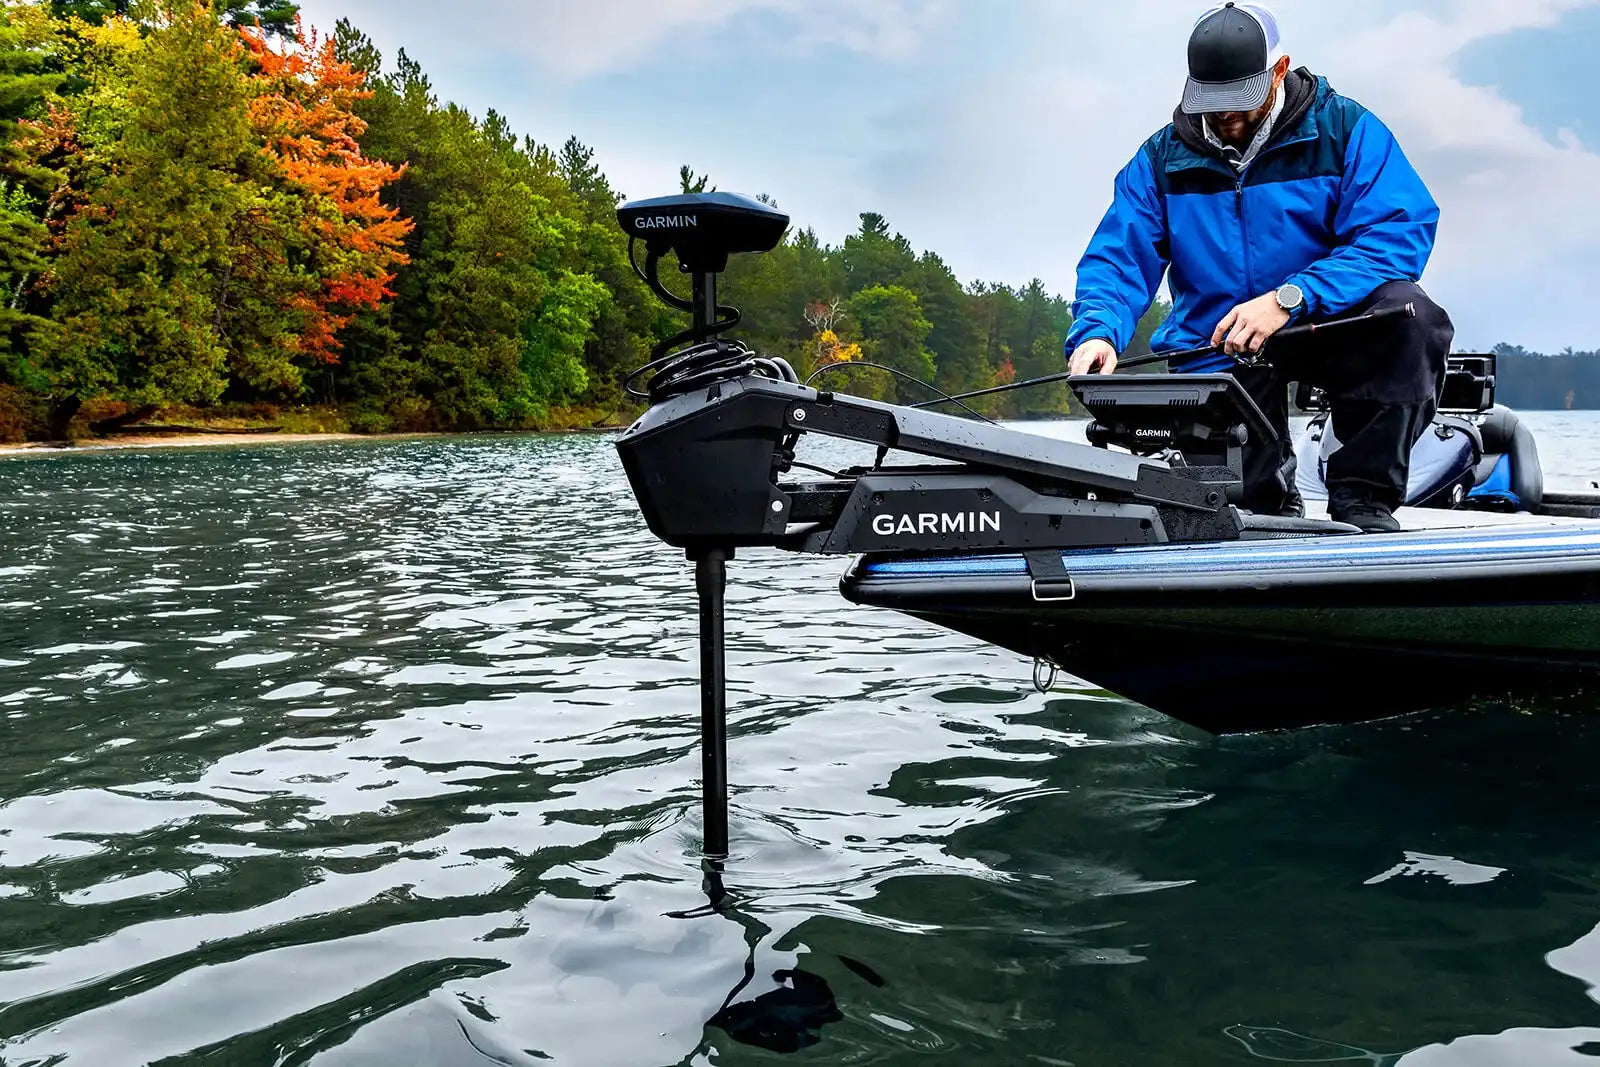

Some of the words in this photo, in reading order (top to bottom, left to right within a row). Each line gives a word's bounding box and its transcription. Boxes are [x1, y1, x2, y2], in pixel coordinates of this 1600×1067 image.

[634, 214, 698, 229] GARMIN
[1135, 428, 1171, 438] GARMIN
[872, 510, 1001, 535] GARMIN
